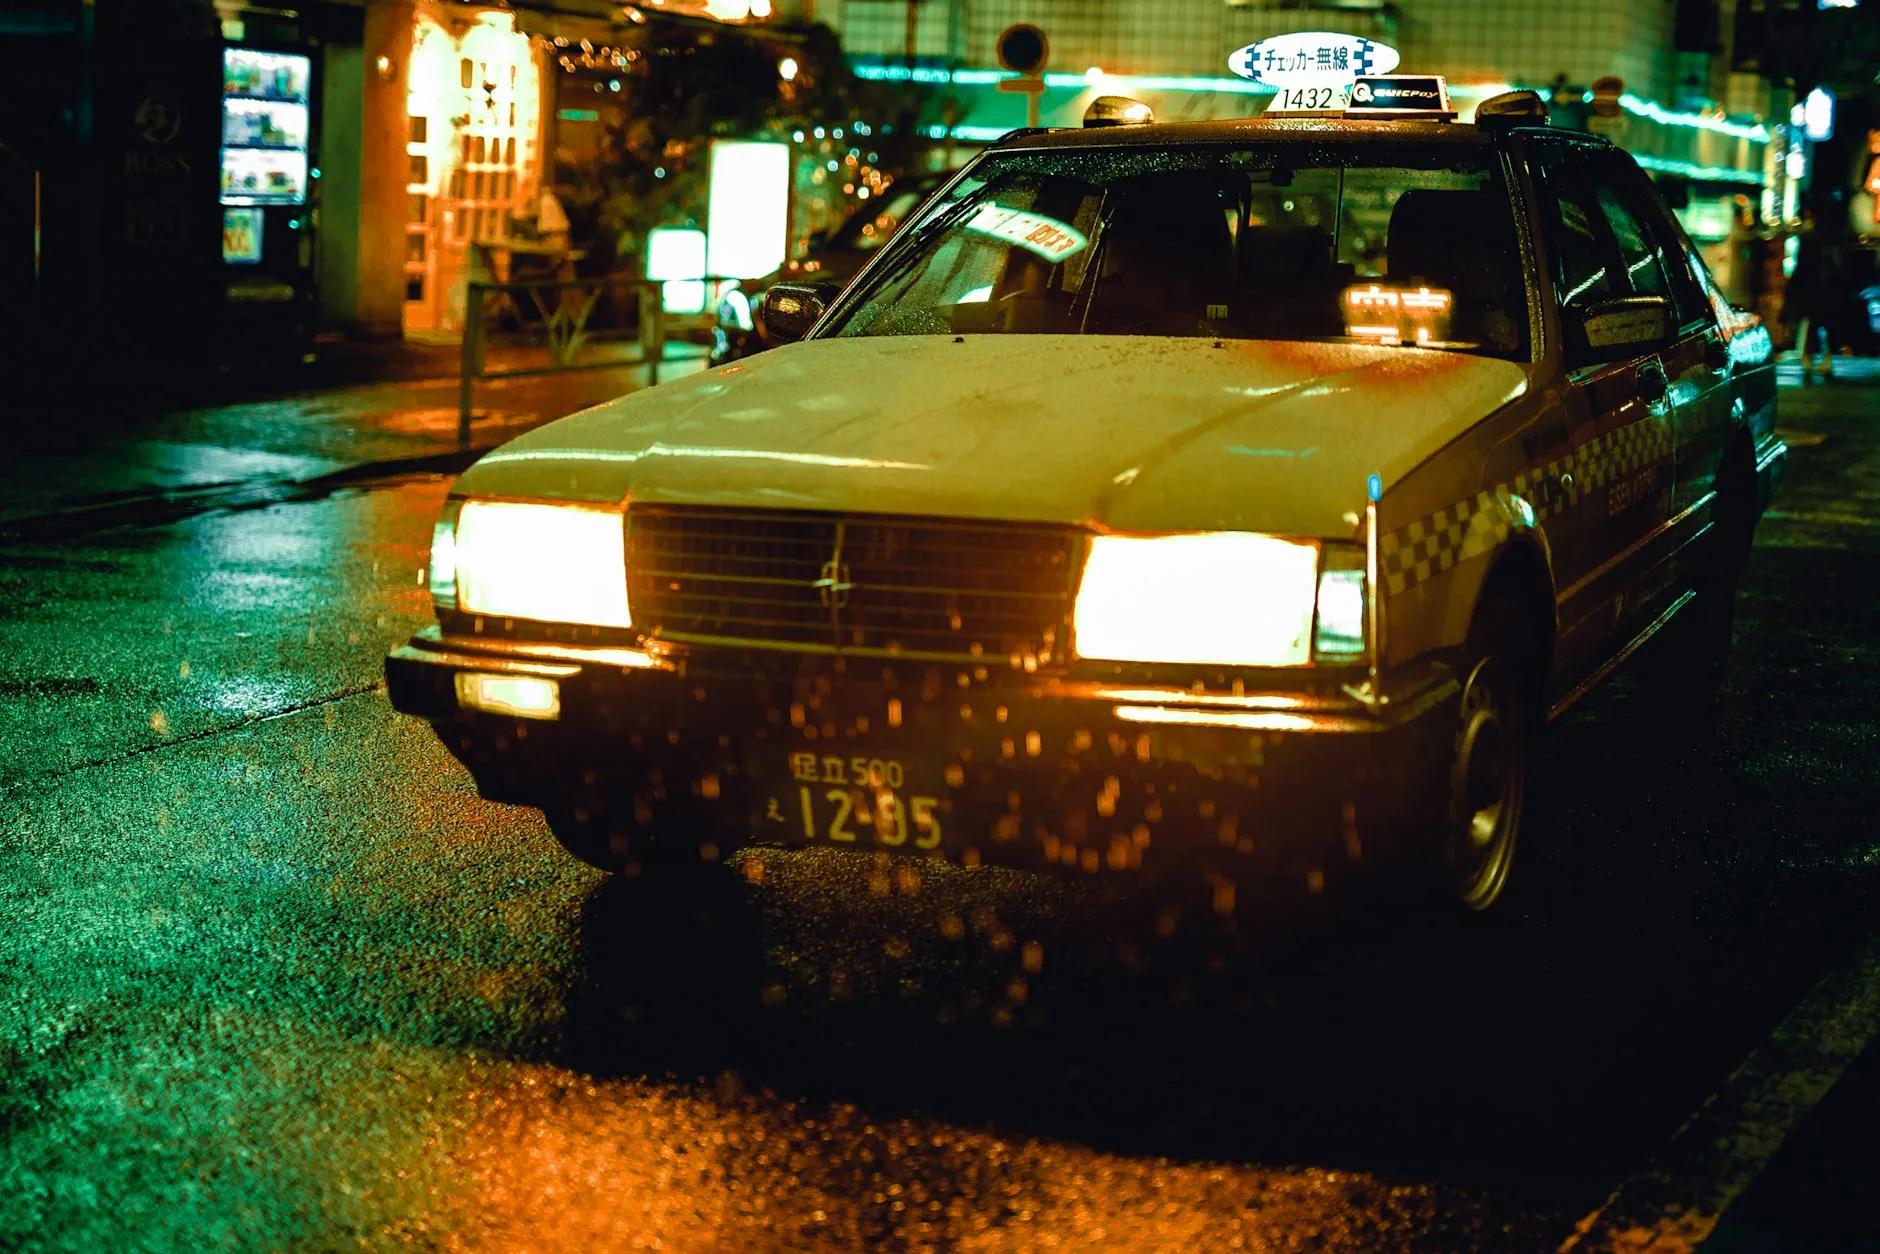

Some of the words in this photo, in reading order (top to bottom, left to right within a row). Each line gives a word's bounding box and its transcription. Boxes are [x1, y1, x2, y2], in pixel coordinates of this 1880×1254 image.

[1264, 46, 1350, 71] チェッカー無線
[1281, 88, 1333, 109] 1432
